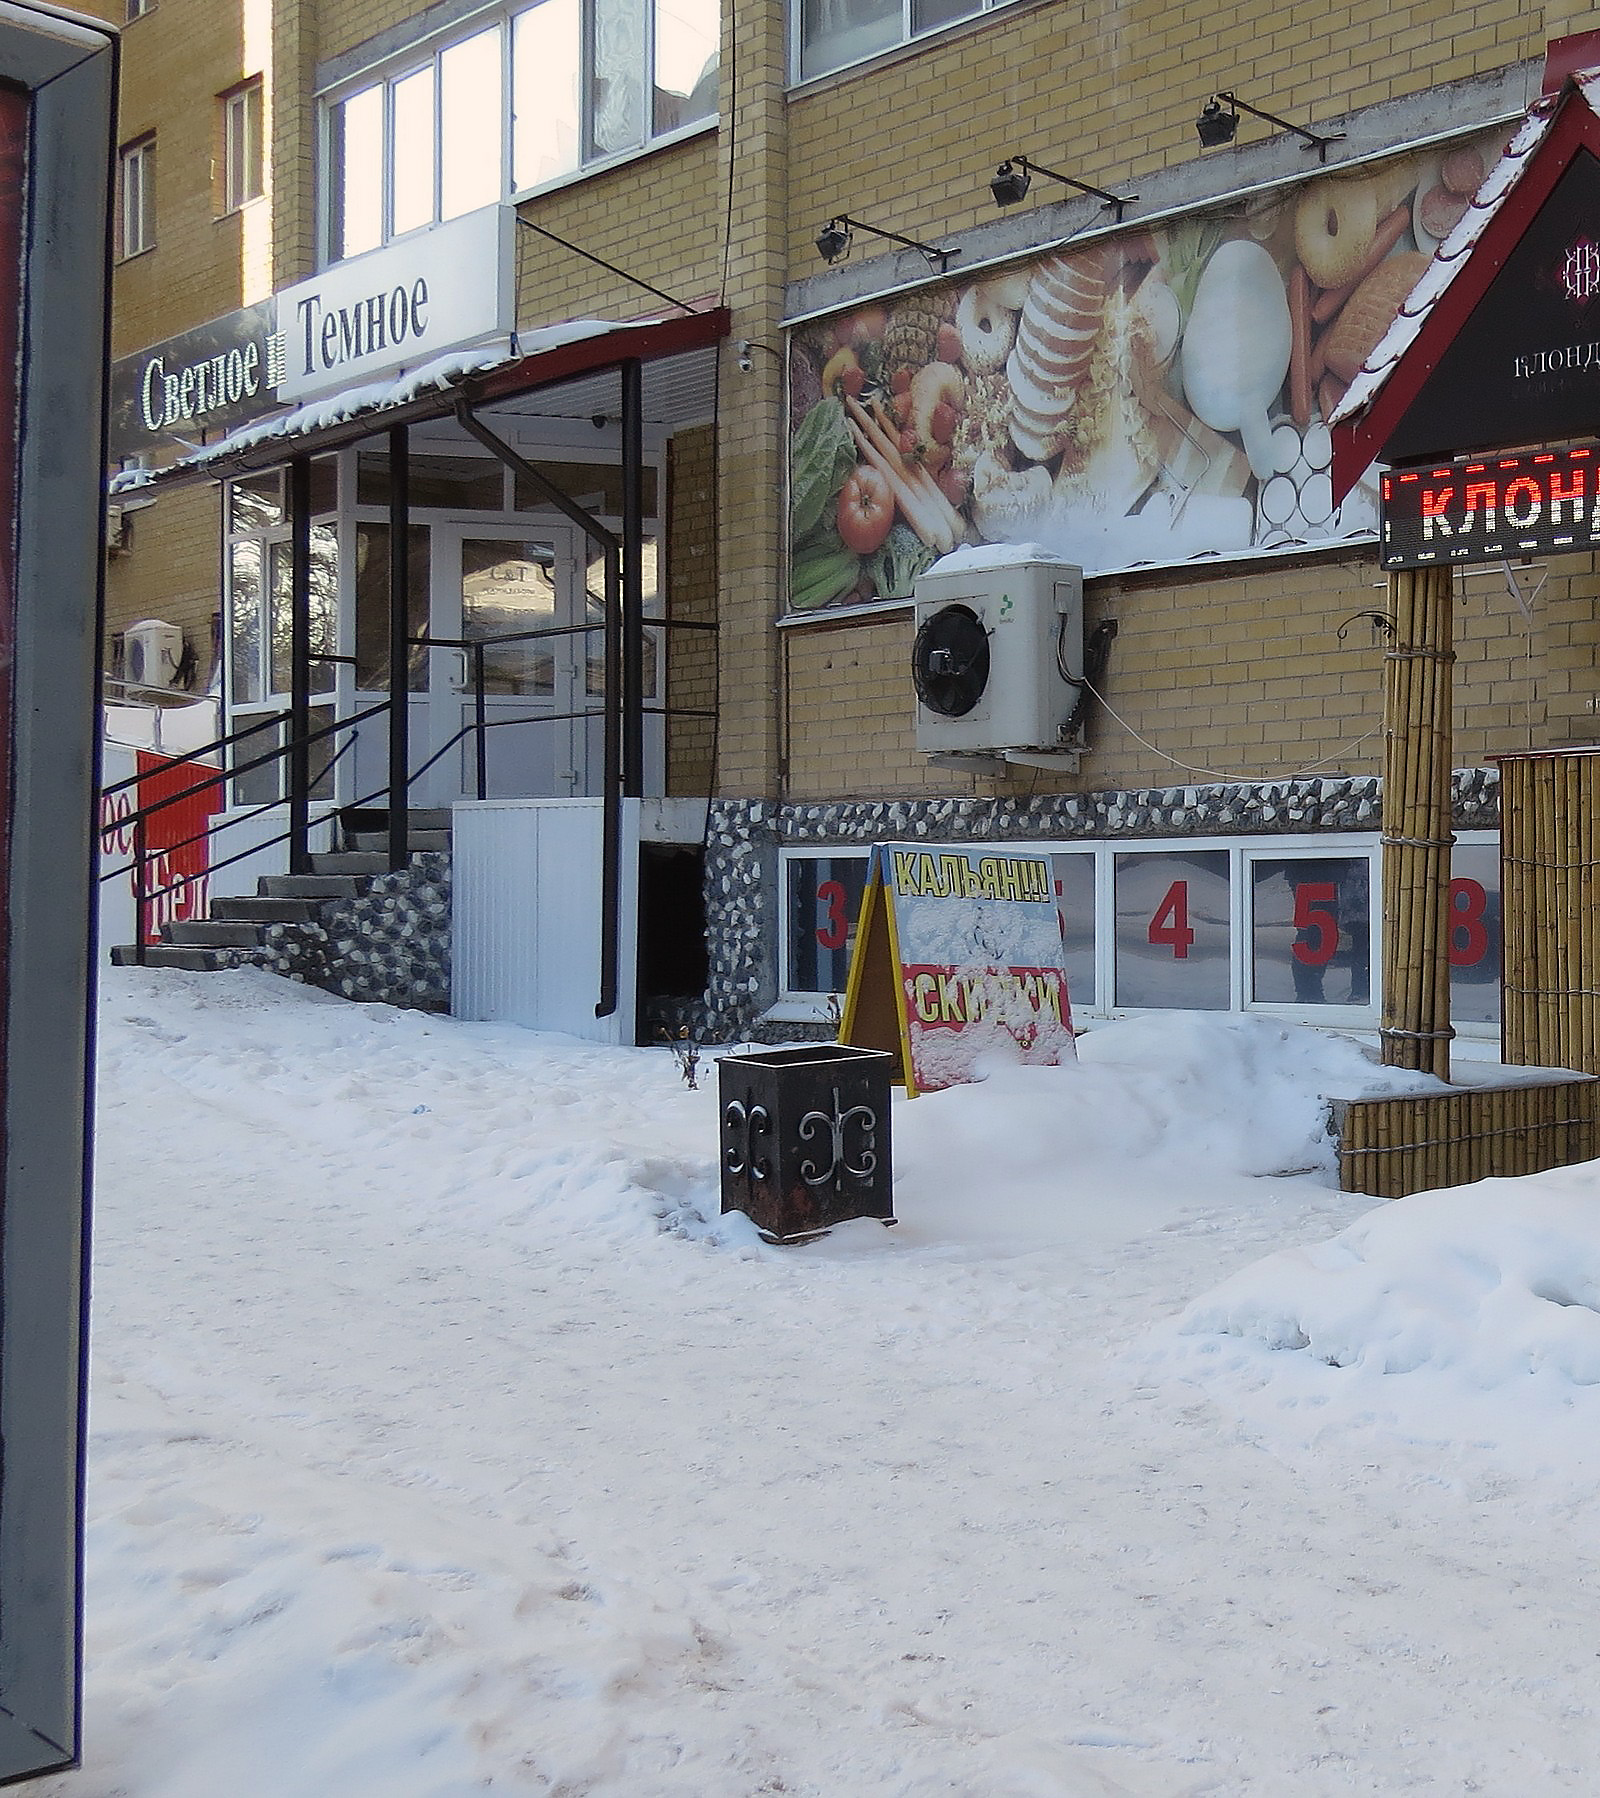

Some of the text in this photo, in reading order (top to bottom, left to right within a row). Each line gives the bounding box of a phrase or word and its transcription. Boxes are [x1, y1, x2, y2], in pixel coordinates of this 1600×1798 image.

[142, 341, 260, 432] Светлое
[296, 276, 430, 377] Темное
[815, 880, 848, 949] 3
[1148, 880, 1194, 959] 4
[1291, 882, 1339, 966] 5
[1449, 877, 1488, 967] 8
[914, 972, 1062, 1024] СКИИ
